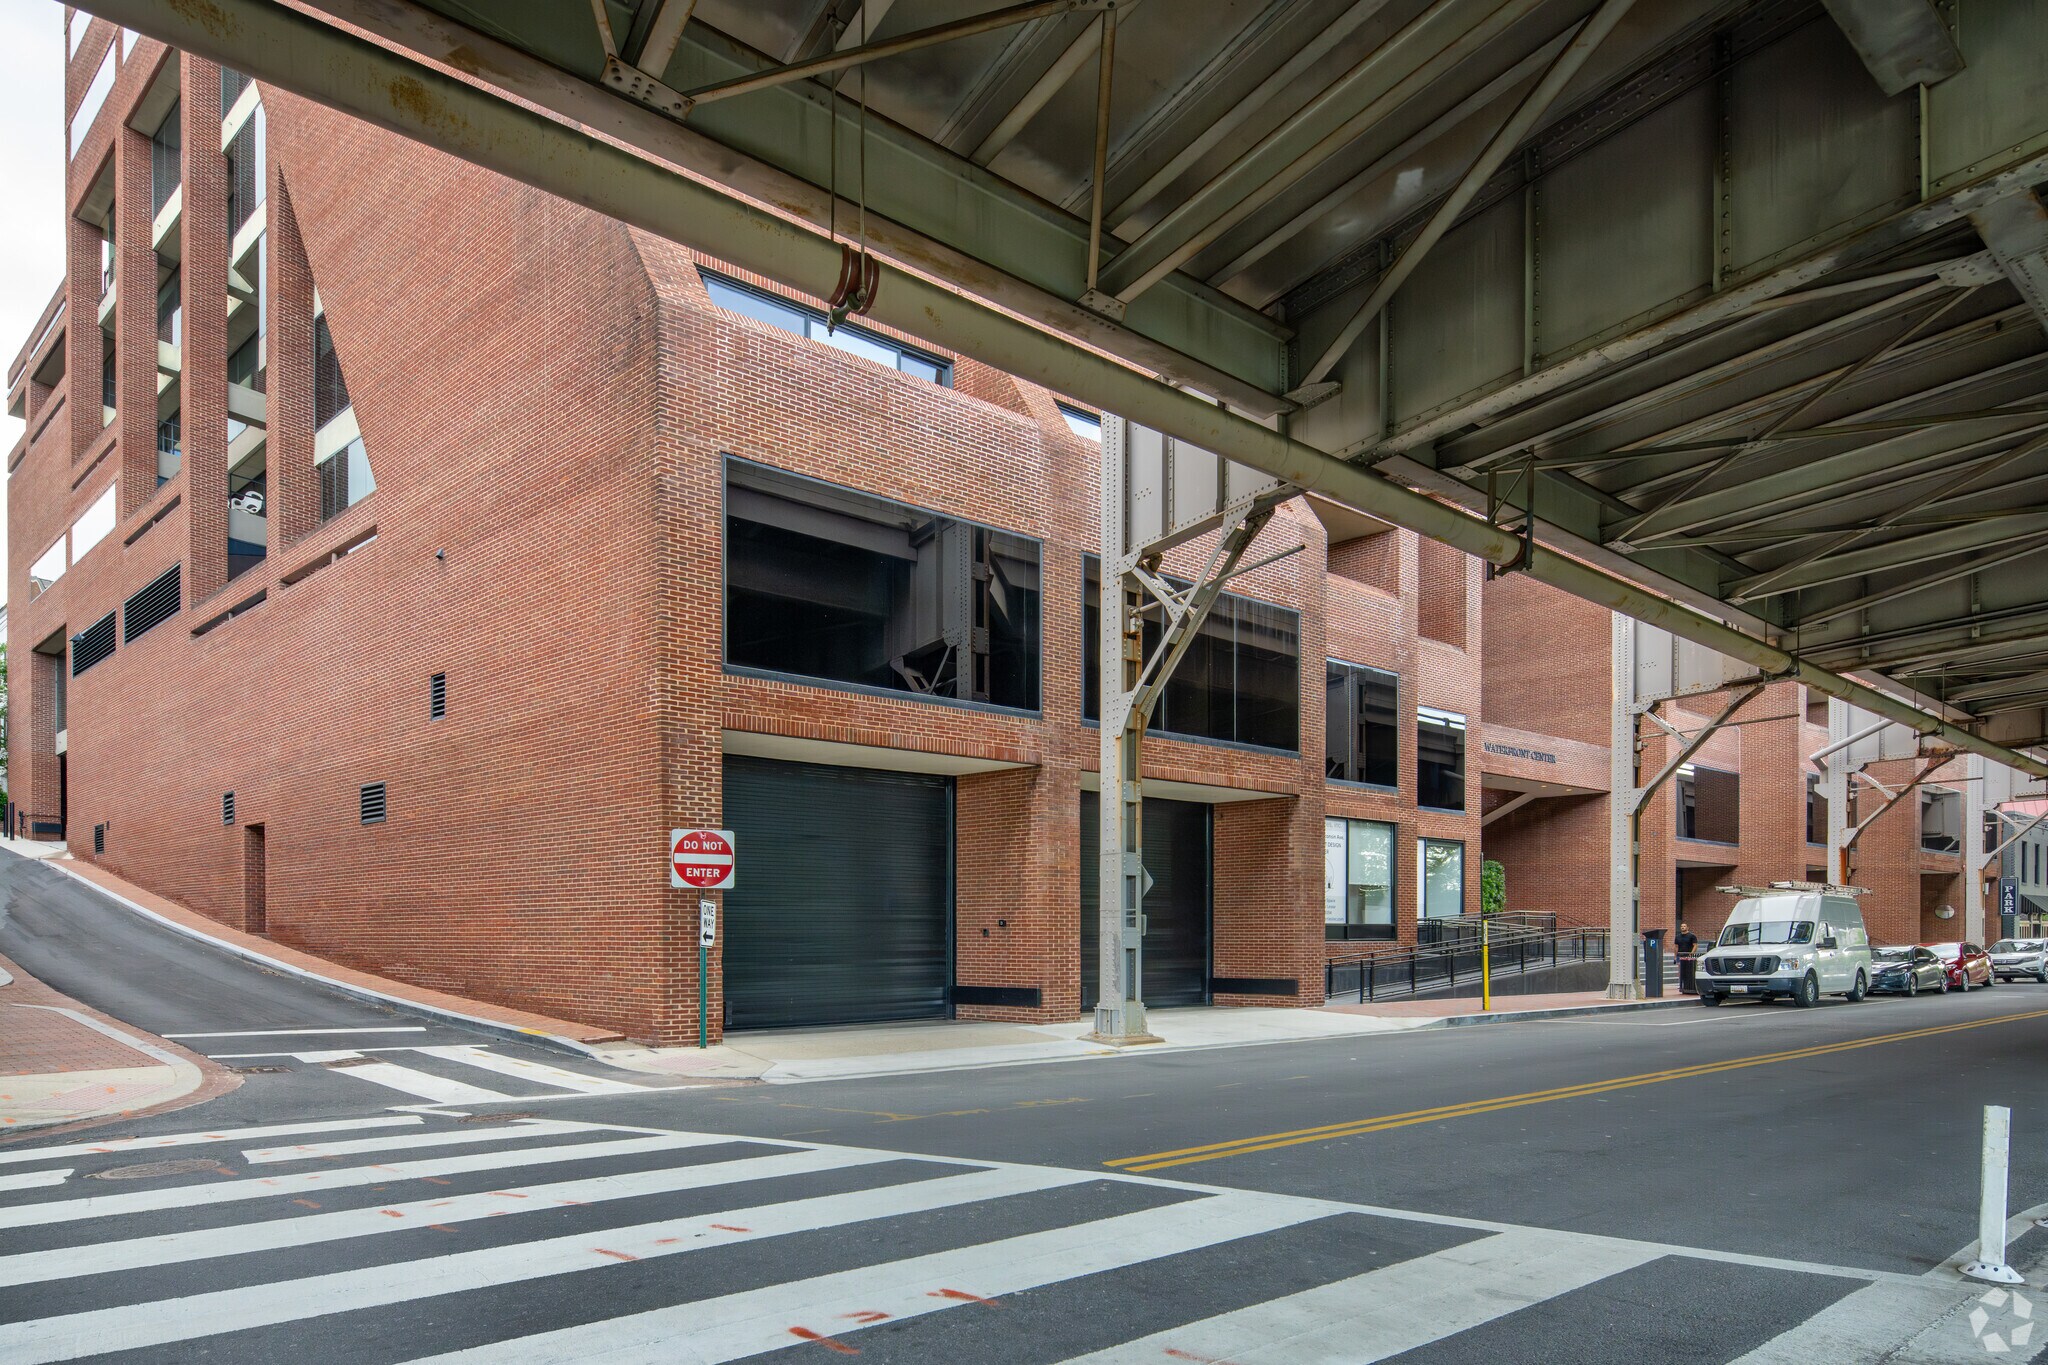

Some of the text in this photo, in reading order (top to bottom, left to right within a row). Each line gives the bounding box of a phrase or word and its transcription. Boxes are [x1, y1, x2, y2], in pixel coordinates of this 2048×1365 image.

[1484, 742, 1556, 763] WATERFRONT CENTER
[683, 840, 724, 851] DO NOT
[686, 867, 721, 878] ENTER
[2003, 885, 2014, 913] PARK
[703, 904, 715, 917] ONE
[703, 917, 715, 929] WAY
[1650, 939, 1656, 947] P
